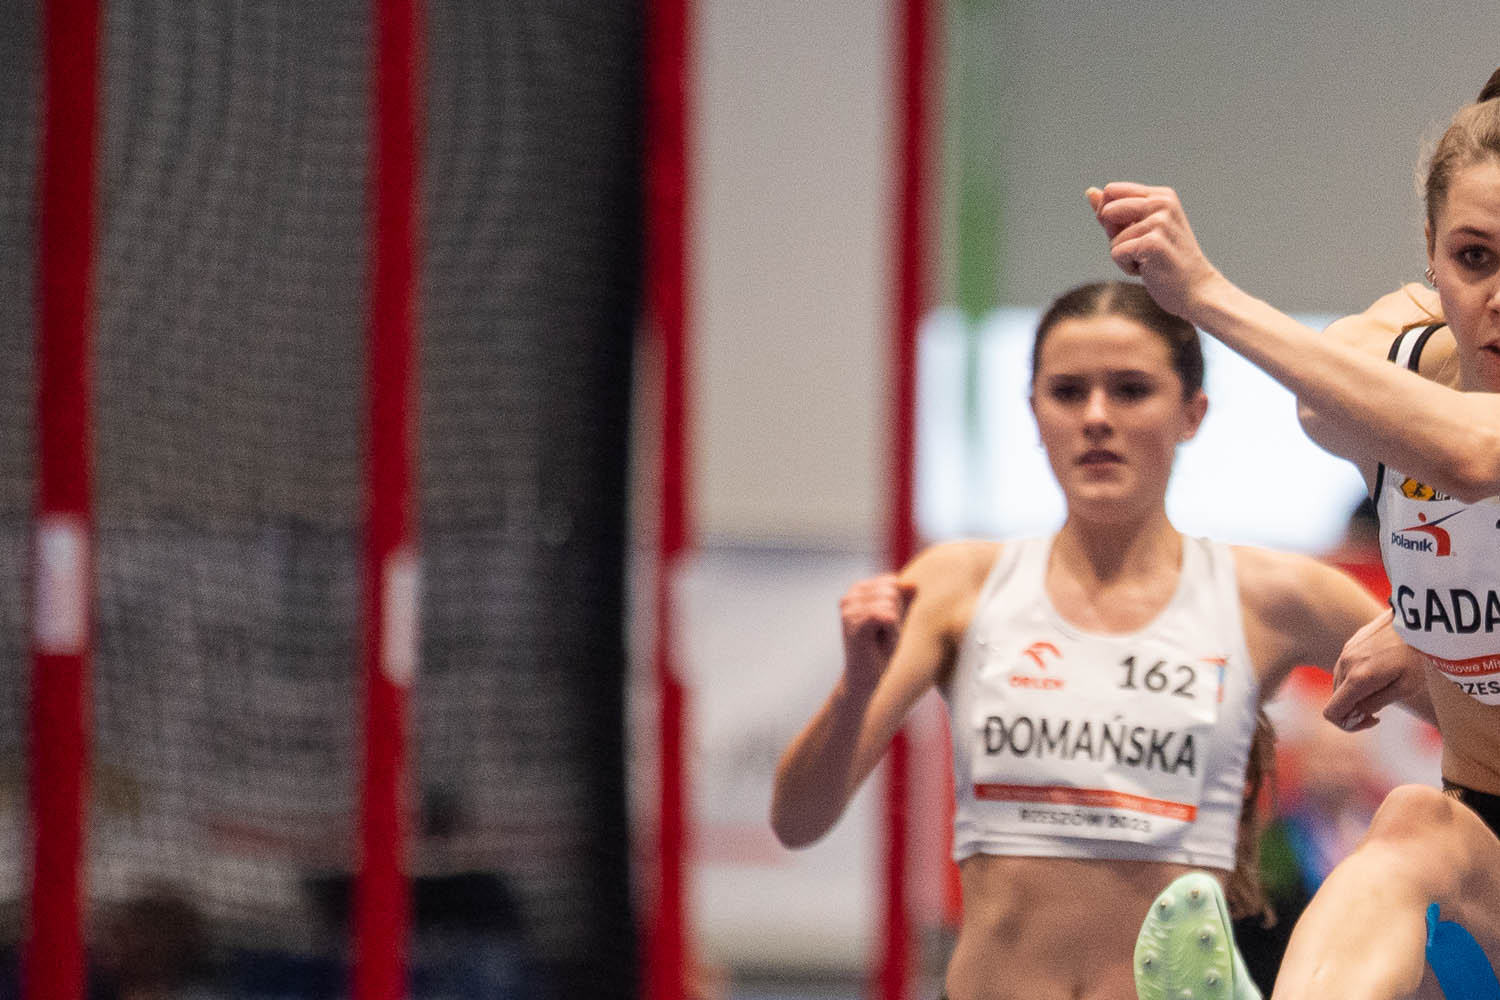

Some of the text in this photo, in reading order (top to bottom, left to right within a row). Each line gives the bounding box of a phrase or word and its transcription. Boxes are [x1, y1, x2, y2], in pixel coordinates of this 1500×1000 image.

[1391, 531, 1433, 553] polanik
[1118, 655, 1198, 699] 162
[982, 714, 1197, 777] DOMAŃSKA
